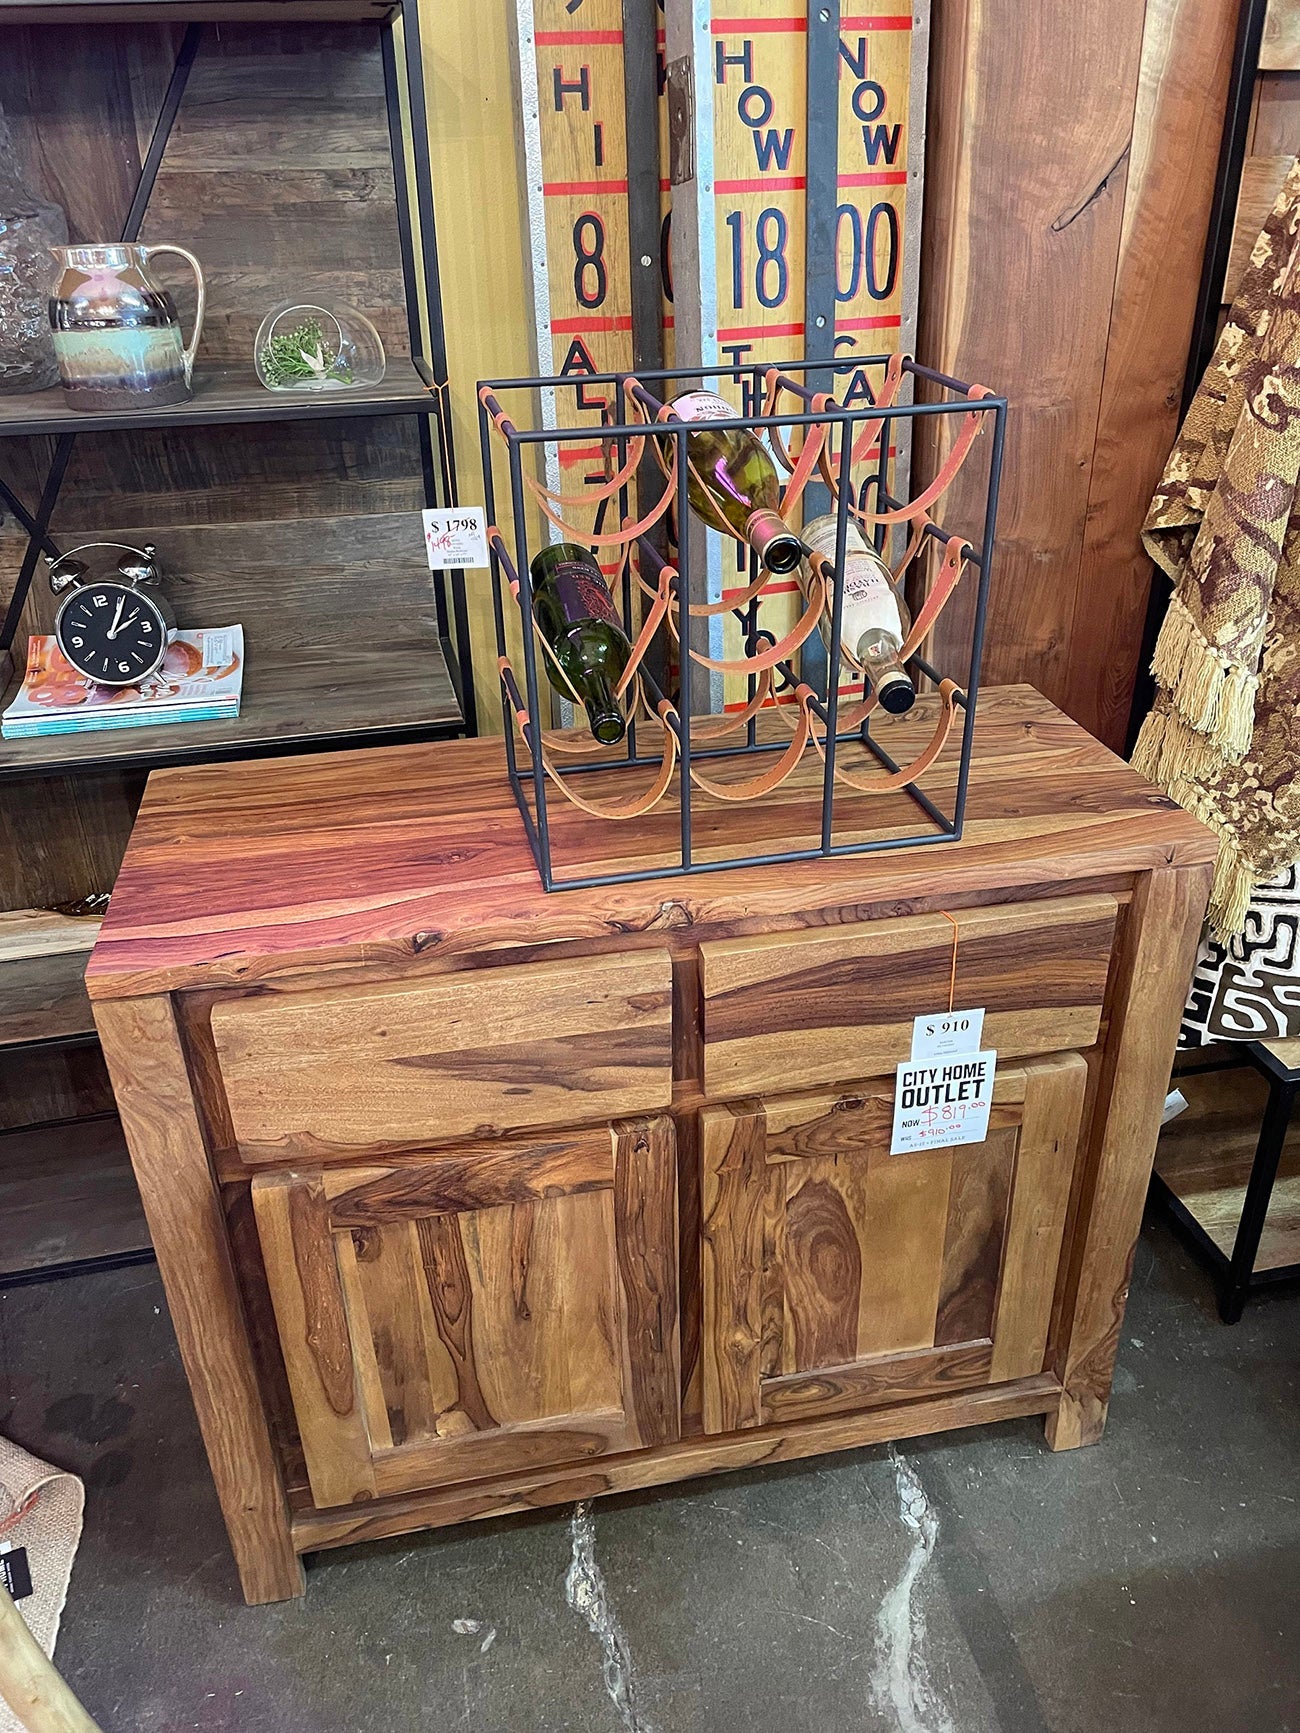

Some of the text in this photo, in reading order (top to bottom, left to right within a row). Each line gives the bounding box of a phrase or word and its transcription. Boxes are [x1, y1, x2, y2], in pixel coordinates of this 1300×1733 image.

[715, 39, 794, 172] HOW
[446, 519, 478, 531] 1798
[92, 594, 109, 608] 12
[140, 620, 153, 633] 3
[71, 636, 84, 648] 9
[118, 661, 130, 673] 6
[940, 1019, 969, 1034] 910
[903, 1061, 987, 1087] CITY HOME
[901, 1078, 985, 1109] OUTLET
[901, 1120, 920, 1128] NOW
